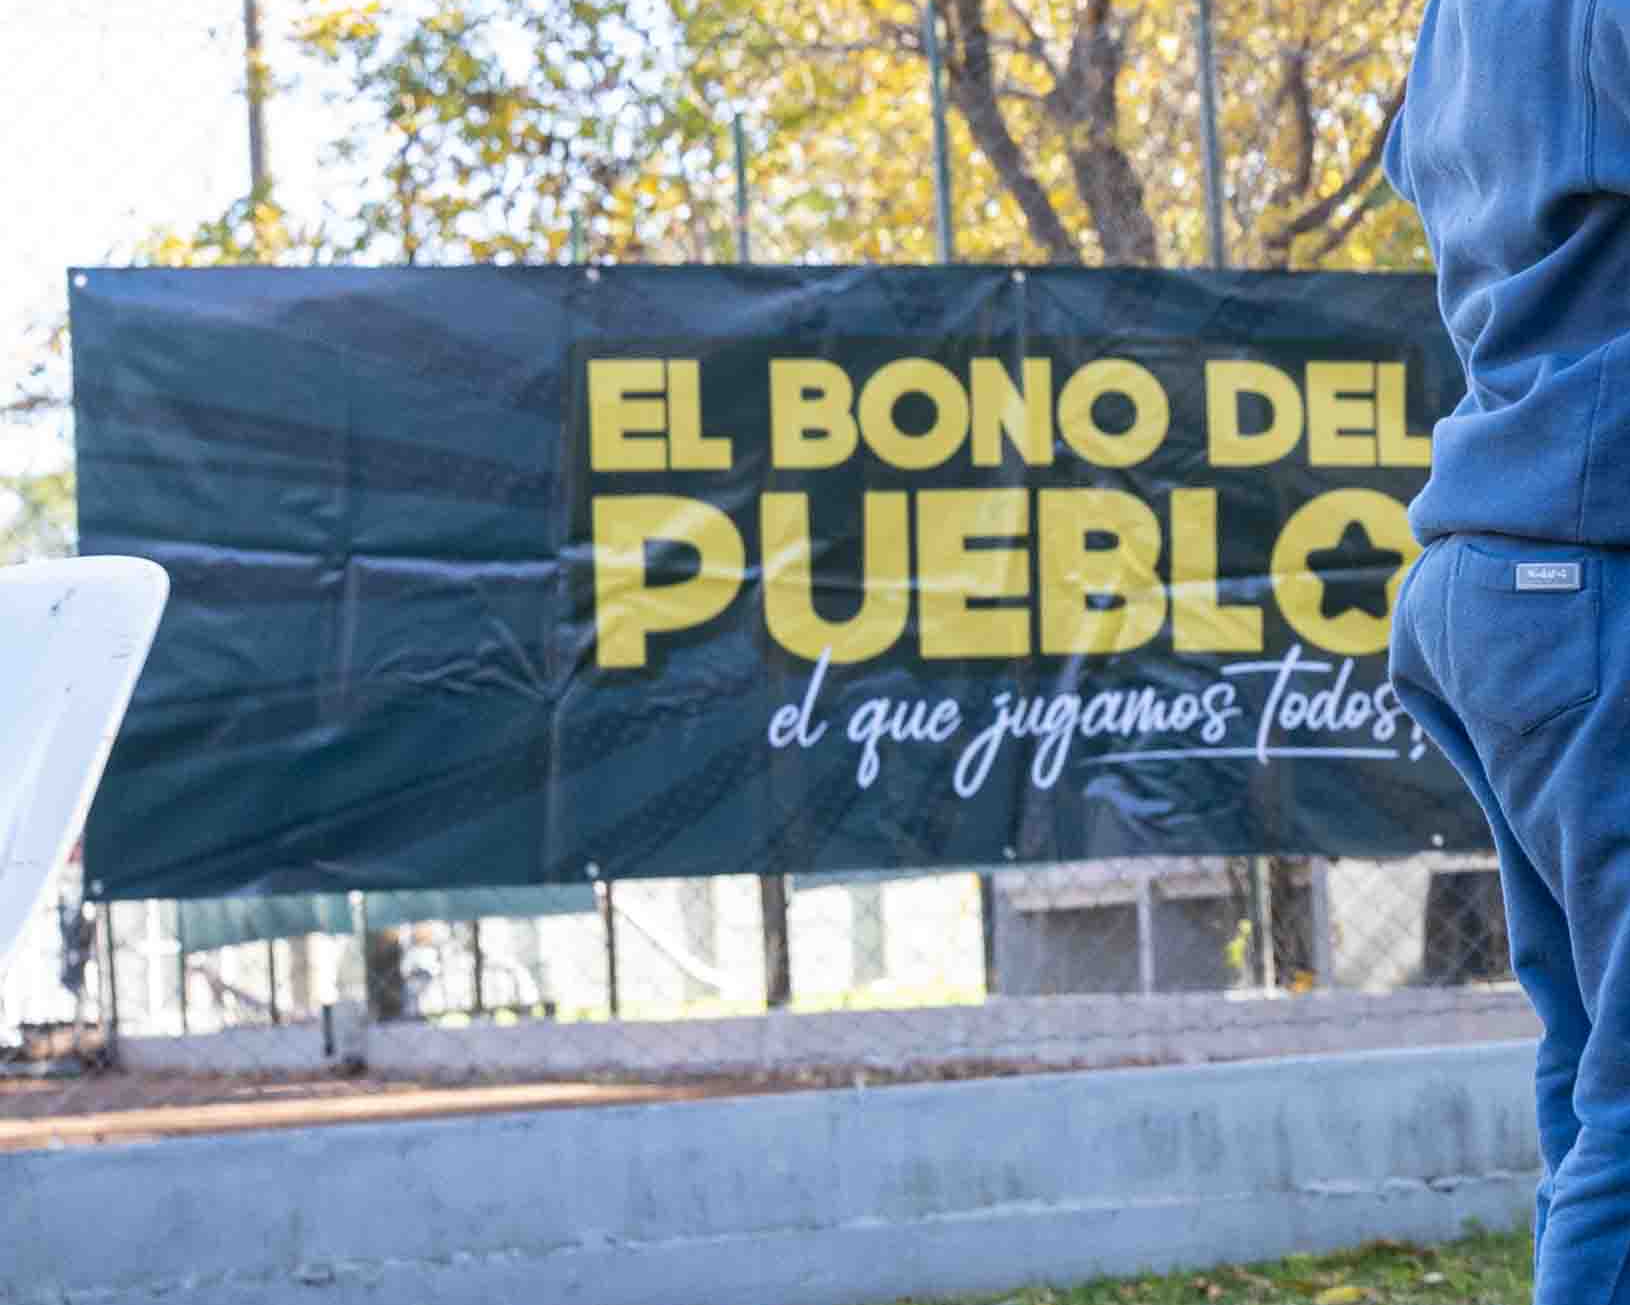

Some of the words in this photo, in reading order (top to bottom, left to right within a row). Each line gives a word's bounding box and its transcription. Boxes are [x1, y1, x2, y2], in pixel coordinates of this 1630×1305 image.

[587, 358, 733, 472] EL
[769, 356, 1170, 471] BONO
[1204, 359, 1433, 468] DEL
[592, 487, 1424, 670] PUEBLO
[768, 644, 829, 748] el
[847, 696, 964, 790] que
[953, 682, 1242, 798] jugamos
